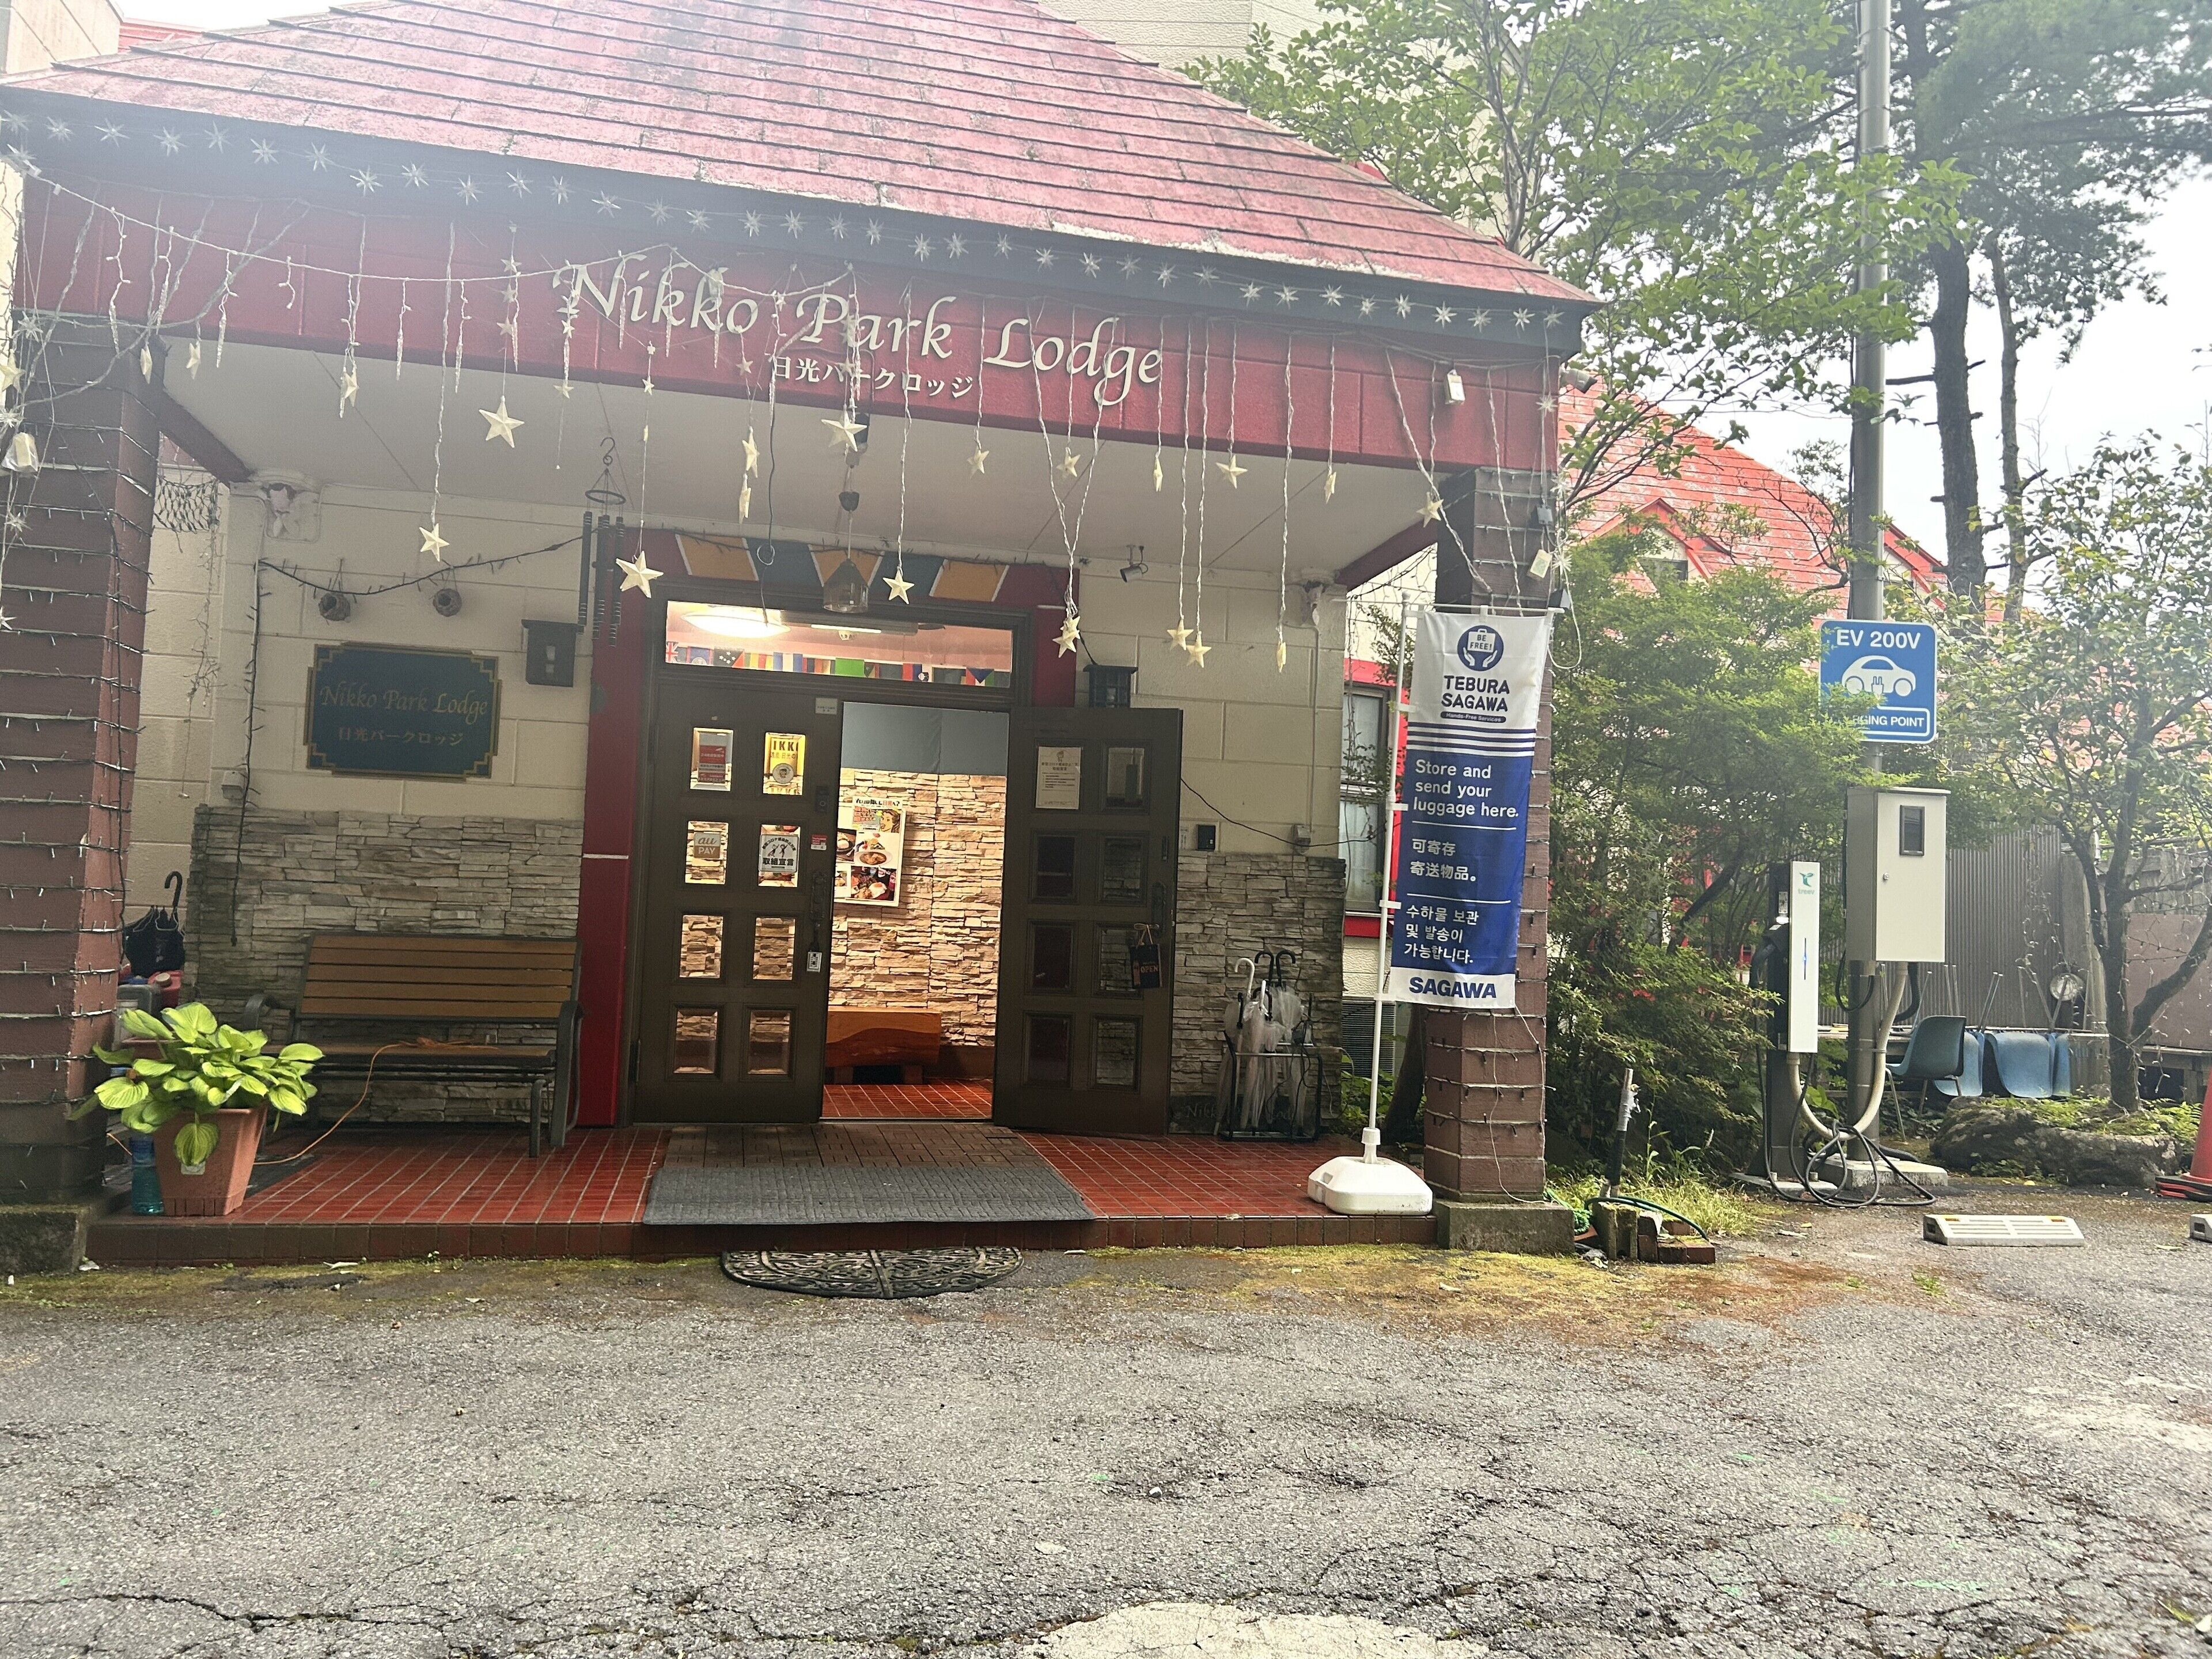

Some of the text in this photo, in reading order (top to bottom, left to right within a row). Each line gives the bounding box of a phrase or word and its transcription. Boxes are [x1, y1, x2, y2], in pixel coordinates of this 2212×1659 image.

[552, 253, 1162, 406] Nikko Park Lodge
[1469, 642, 1493, 650] FREE!
[1836, 629, 1921, 649] EV 200V
[1444, 675, 1510, 695] TEBURA
[320, 680, 488, 725] Nikko Park Lodge
[1441, 693, 1508, 712] SAGAWA
[1890, 716, 1925, 727] POINT
[1415, 759, 1491, 779] Store and
[1415, 781, 1492, 798] send your
[1413, 797, 1519, 817] luggage here.
[698, 847, 716, 855] PAY
[1412, 838, 1456, 857] 可寄存
[1410, 861, 1476, 881] 寄送物品。
[1406, 904, 1479, 925] 수하물 보관
[1406, 923, 1463, 944] 및 발송이
[1404, 943, 1474, 964] 가능합니다.
[1140, 964, 1158, 974] OPEN
[1409, 976, 1497, 999] SAGAWA
